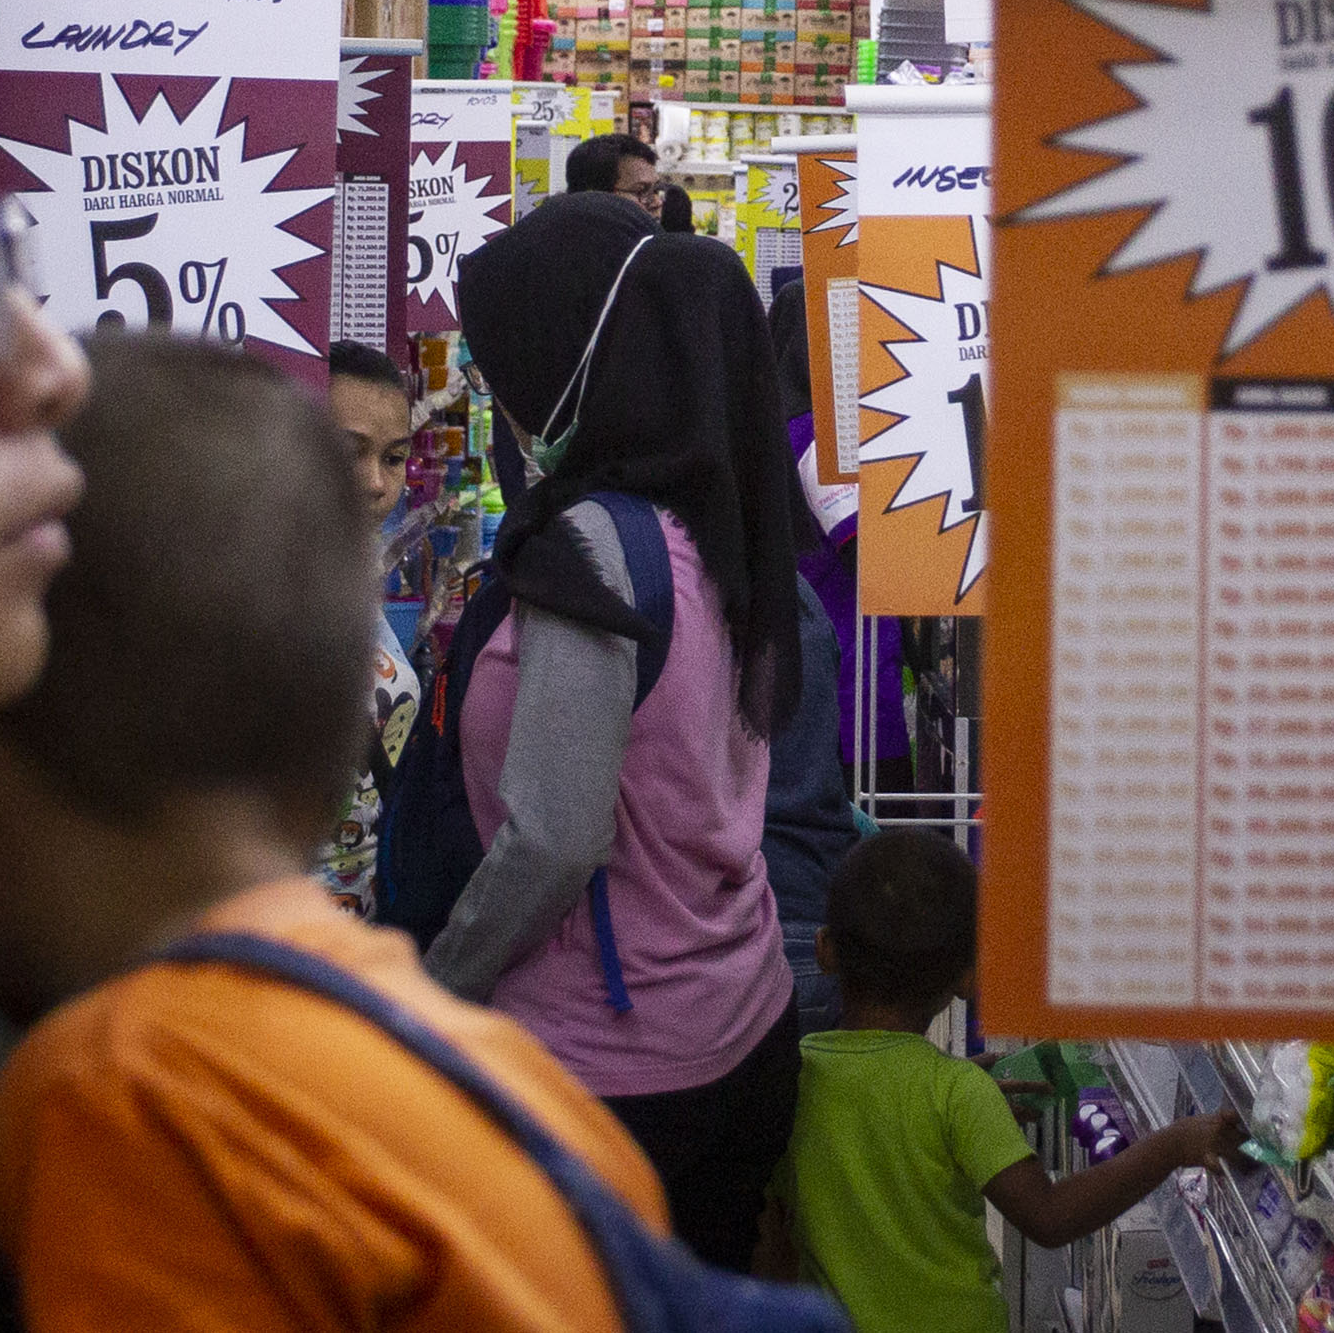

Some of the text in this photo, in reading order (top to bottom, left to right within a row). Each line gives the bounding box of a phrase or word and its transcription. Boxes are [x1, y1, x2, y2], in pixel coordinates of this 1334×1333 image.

[21, 19, 210, 56] LAUNDRY
[80, 145, 221, 193] DISKON
[83, 185, 224, 213] DARI HARGA NORMAL
[89, 212, 248, 346] 5%
